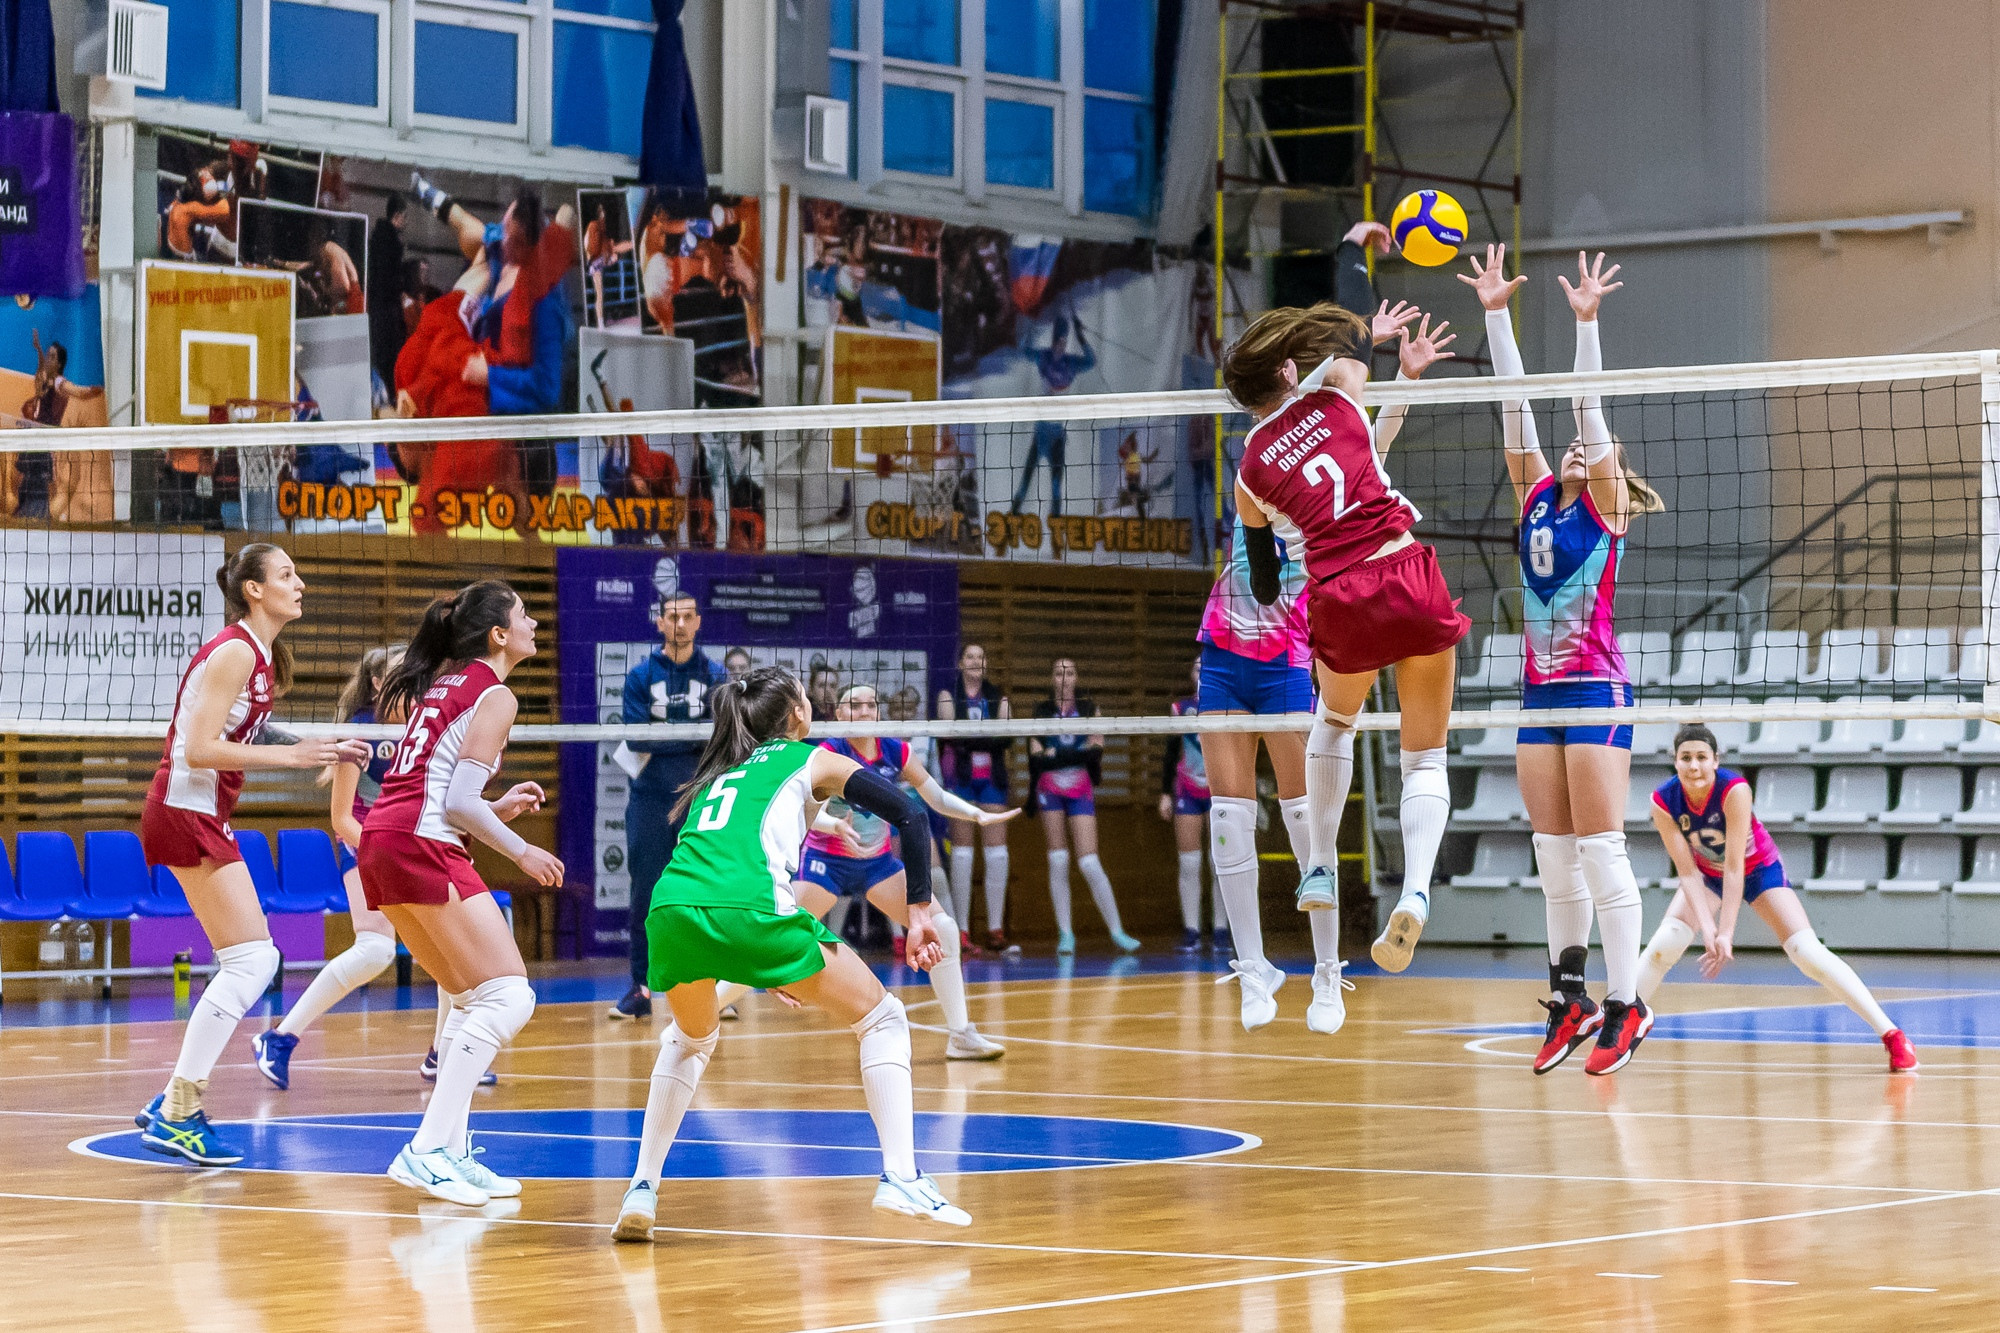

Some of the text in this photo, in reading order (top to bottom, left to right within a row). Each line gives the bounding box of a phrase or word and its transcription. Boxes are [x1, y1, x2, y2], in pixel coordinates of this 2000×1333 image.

[1260, 409, 1327, 467] ИРКУТСКАЯ
[1277, 427, 1332, 473] ОБЛАСТЬ
[277, 481, 404, 524] СПОРТ
[435, 488, 517, 530] ЭТО
[1302, 453, 1361, 520] 2
[25, 586, 201, 623] жилищная
[25, 629, 201, 666] инициатива
[697, 770, 747, 832] 5
[810, 859, 827, 877] 10
